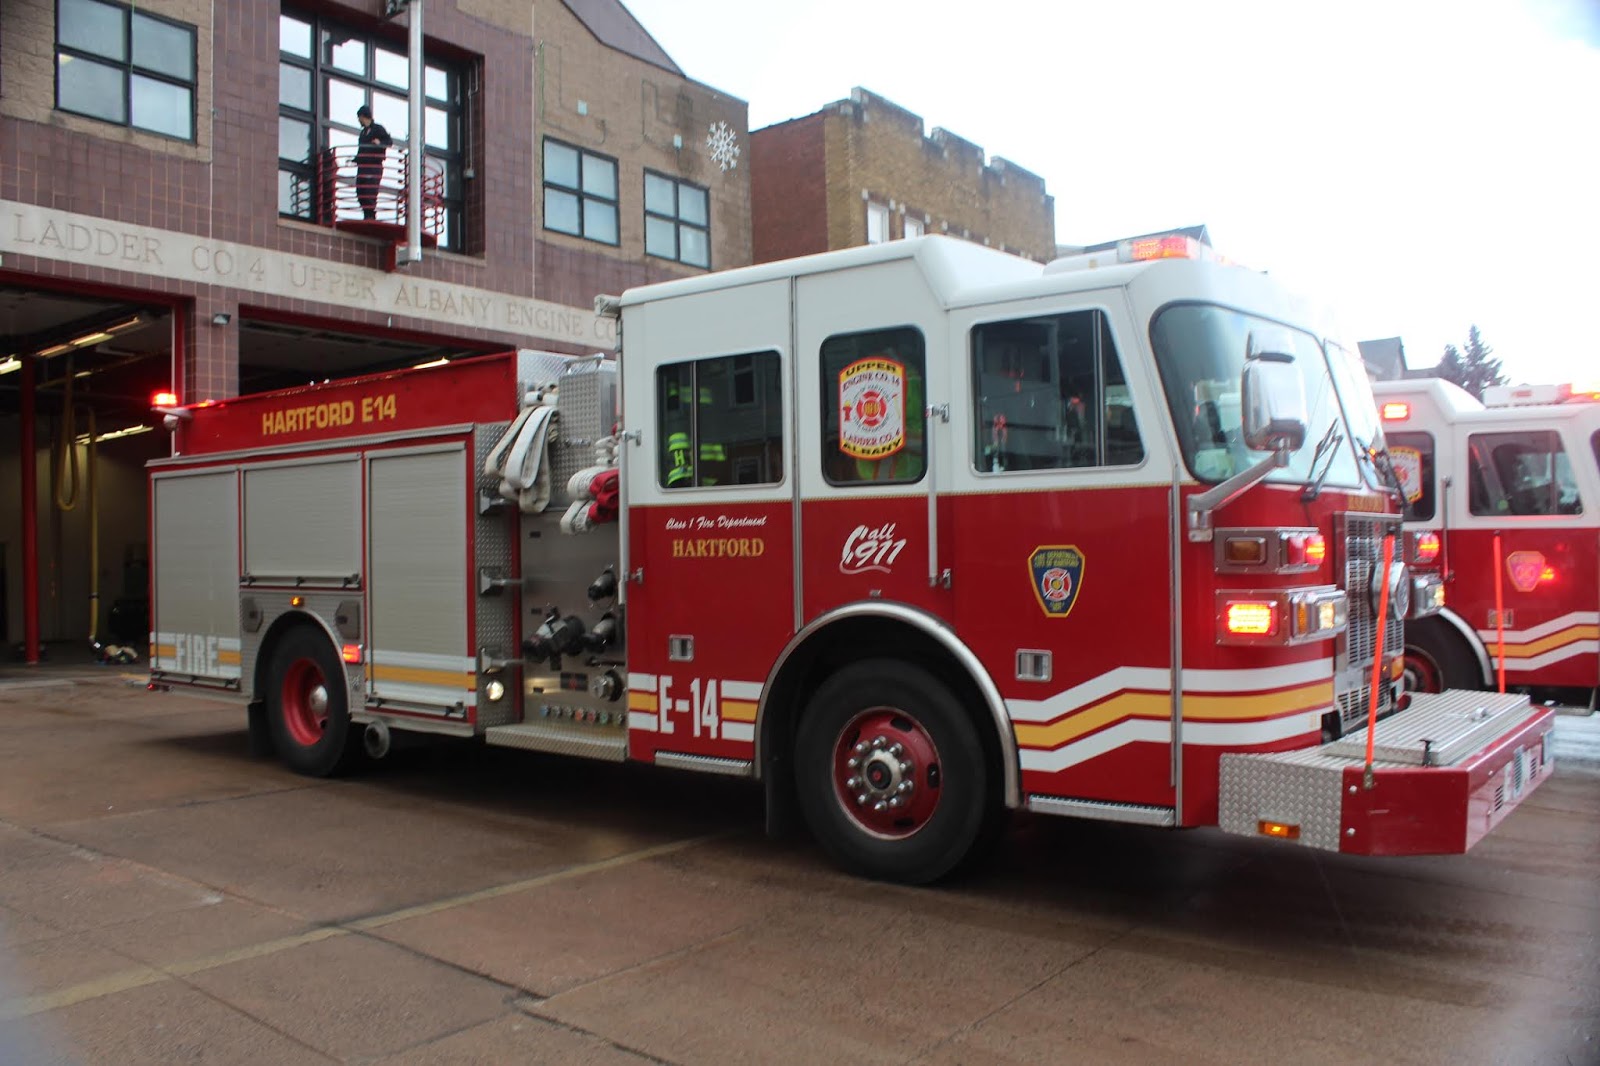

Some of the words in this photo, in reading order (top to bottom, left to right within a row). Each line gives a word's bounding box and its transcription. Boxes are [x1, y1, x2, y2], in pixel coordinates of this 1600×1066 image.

[13, 213, 164, 265] LADDER
[249, 255, 265, 281] 4
[288, 262, 379, 301] UPPER
[394, 283, 493, 321] ALBANY
[505, 301, 584, 337] ENGINE
[846, 361, 897, 377] UPPER
[262, 400, 355, 435] HARTFORD
[361, 393, 398, 423] E14
[843, 437, 902, 455] ALBANY
[665, 517, 687, 530] Class
[688, 517, 695, 529] 1
[696, 516, 715, 530] Fire
[717, 514, 768, 530] Department
[672, 538, 765, 558] HARTFORD
[842, 522, 897, 565] Call
[855, 538, 907, 567] 911
[176, 632, 219, 676] FIRE
[659, 675, 719, 739] E-14
